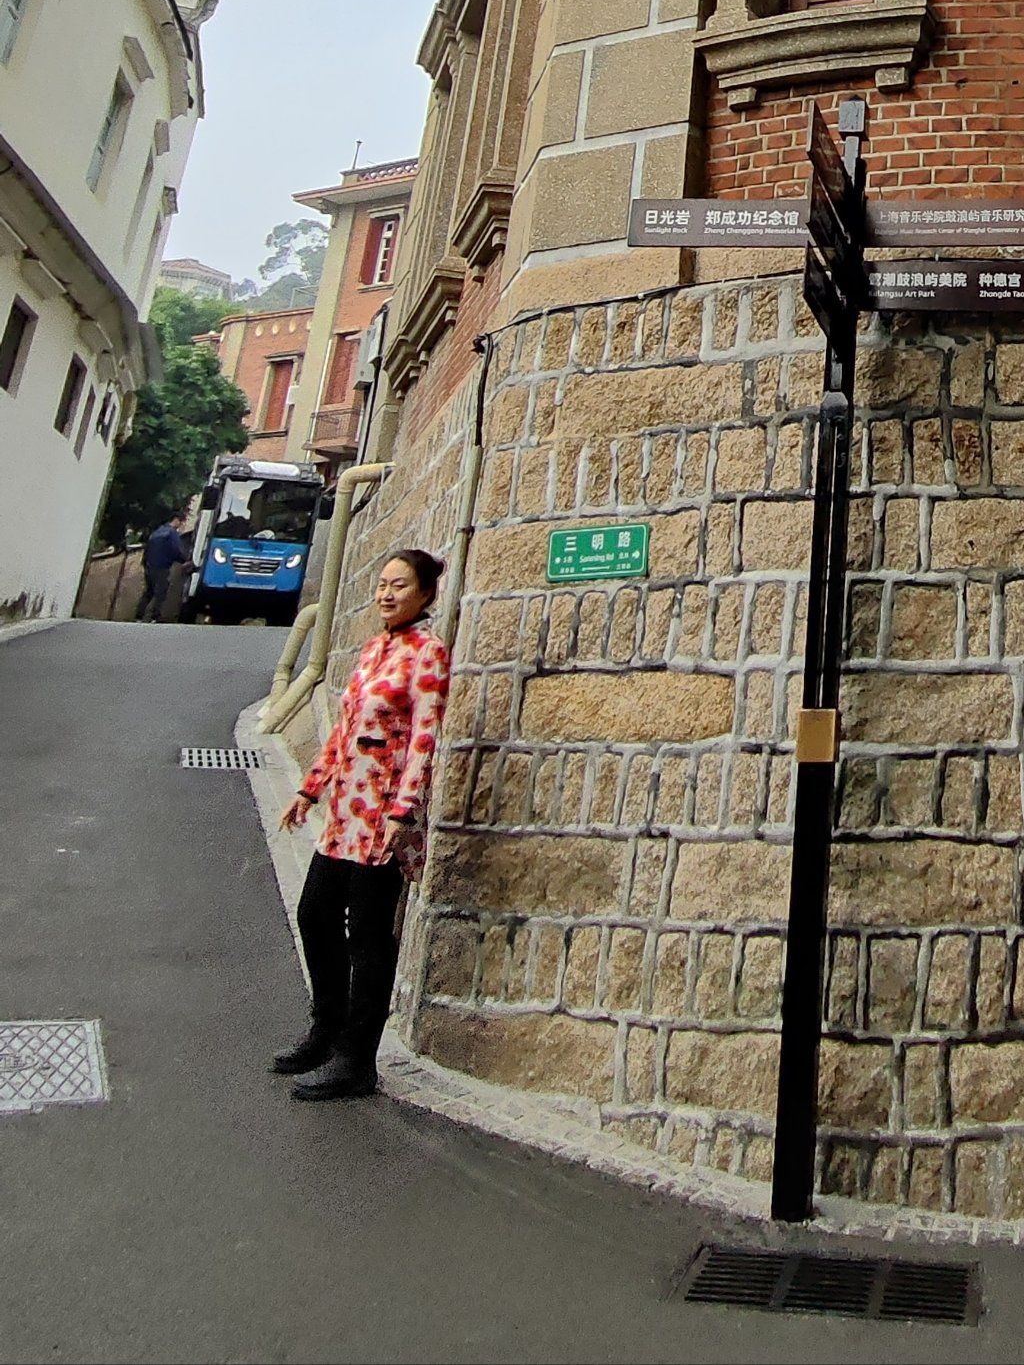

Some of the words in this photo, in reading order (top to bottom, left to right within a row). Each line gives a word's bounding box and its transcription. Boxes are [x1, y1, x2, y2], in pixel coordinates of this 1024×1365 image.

[645, 210, 690, 225] 日光岩
[705, 210, 799, 226] 郑成功纪念馆
[979, 273, 1021, 287] 种德宫
[918, 290, 935, 298] Park
[979, 290, 1011, 298] Zhongde
[564, 531, 631, 552] 三明路
